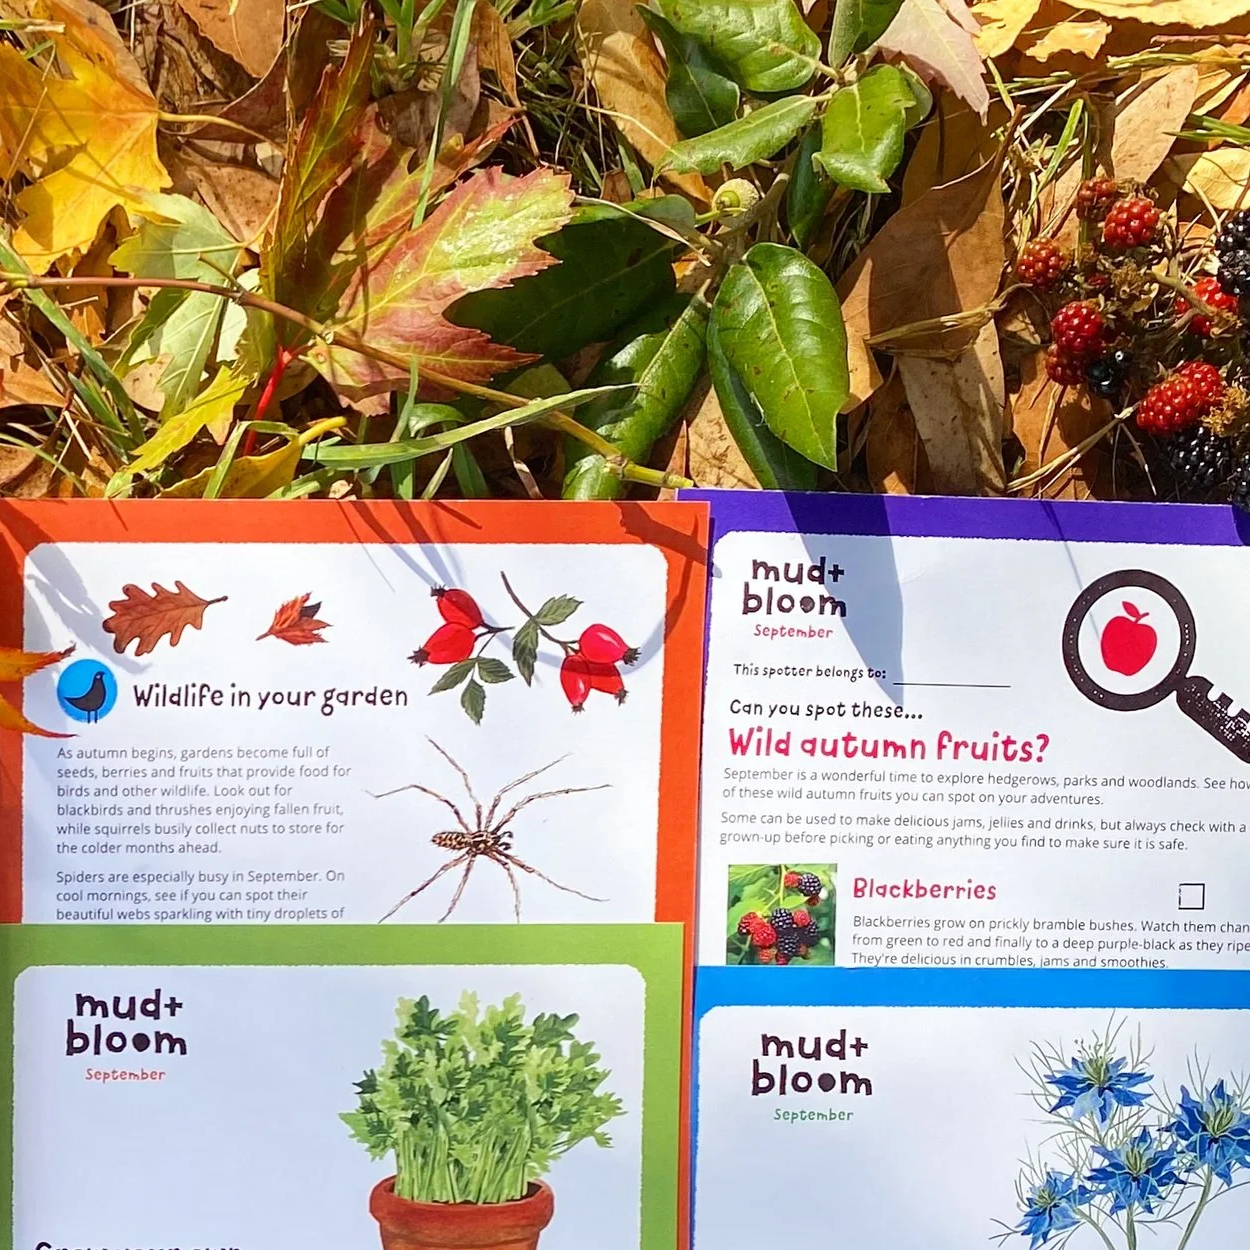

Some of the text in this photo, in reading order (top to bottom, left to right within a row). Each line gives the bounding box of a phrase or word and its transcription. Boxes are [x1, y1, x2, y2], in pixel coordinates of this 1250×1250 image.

[753, 557, 844, 583] mud+
[742, 582, 846, 617] bloom
[753, 623, 834, 641] September
[733, 663, 888, 683] This spotter belongs to:
[133, 682, 407, 716] Wildlife in your garden
[729, 698, 923, 721] Can you spot these...
[56, 745, 331, 763] As autumn begins, gardens become full of
[729, 727, 1049, 762] Wild autumn fruits?
[722, 785, 1104, 807] of these wild autumn fruits you can spot on your adventures.
[56, 841, 221, 854] the colder months ahead.
[853, 877, 997, 901] Blackberries
[75, 989, 182, 1019] mud+
[66, 1019, 187, 1056] bloom
[761, 1029, 868, 1059] mud+
[85, 1067, 166, 1084] September
[752, 1059, 872, 1096] bloom
[773, 1107, 854, 1124] September
